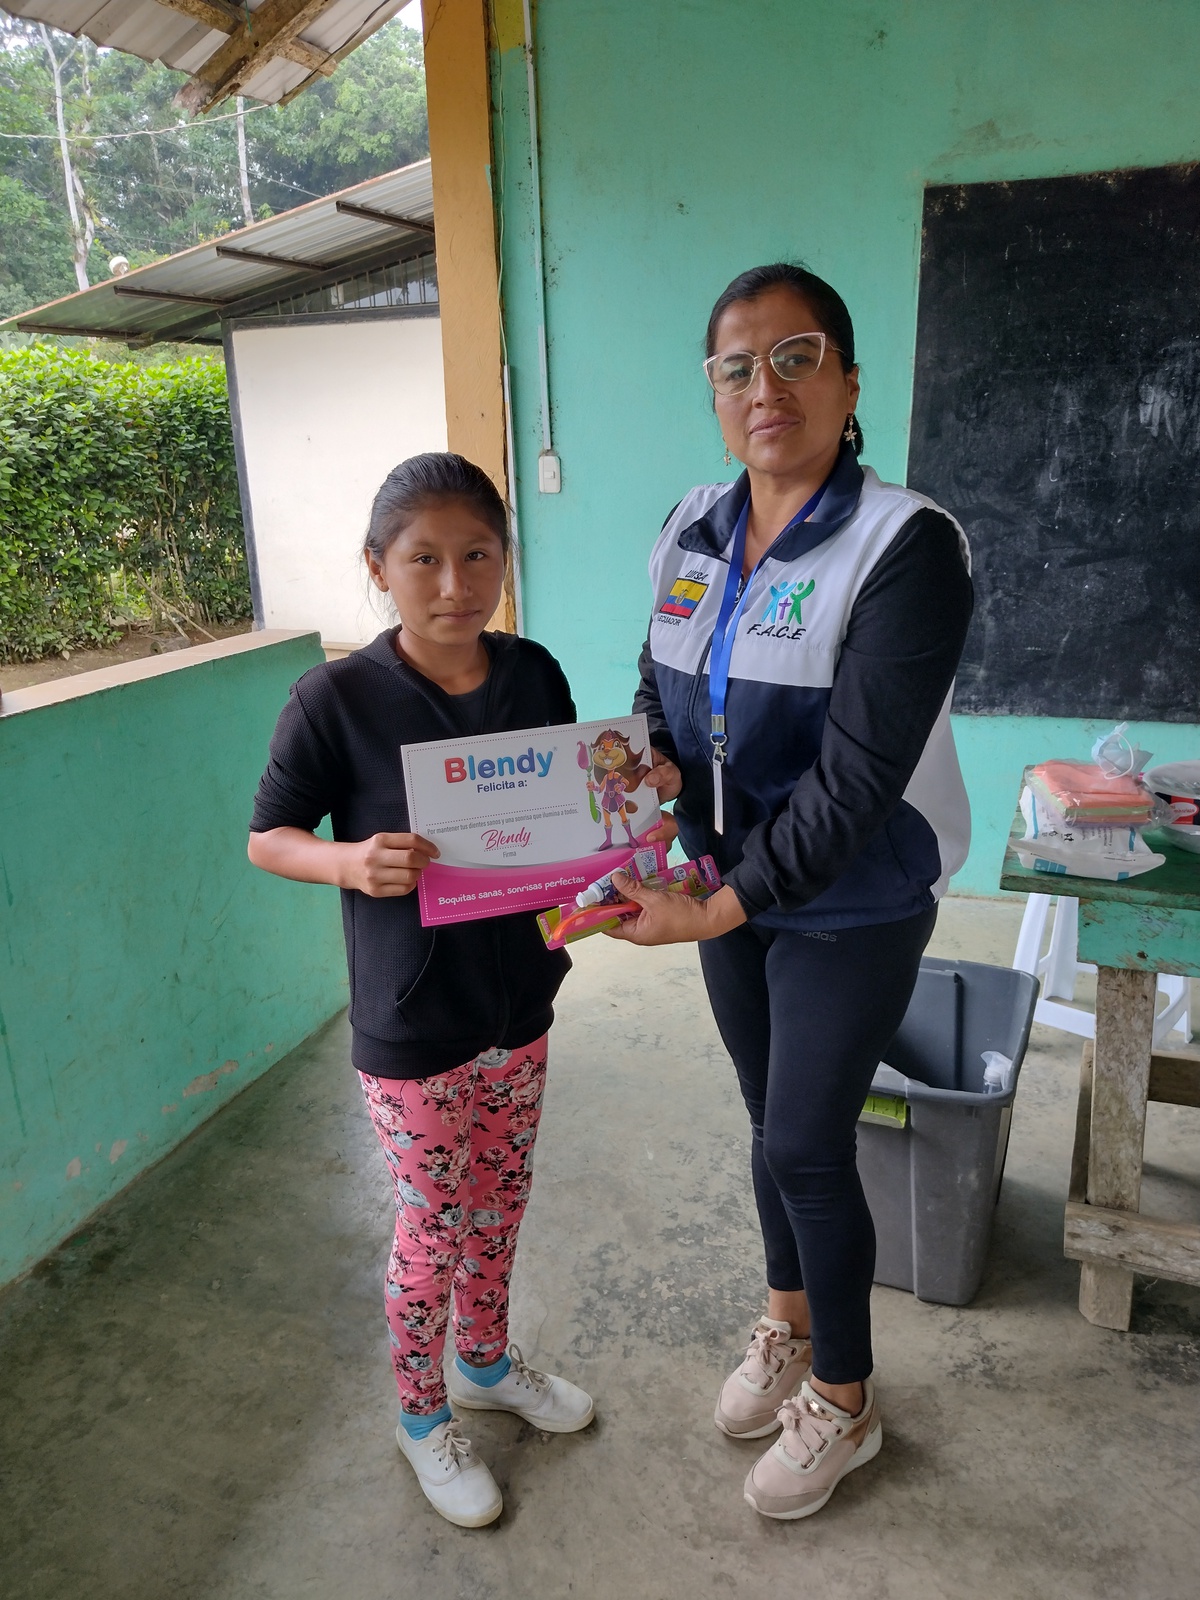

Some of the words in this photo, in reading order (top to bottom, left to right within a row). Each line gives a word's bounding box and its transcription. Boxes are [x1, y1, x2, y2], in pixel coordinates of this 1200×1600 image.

[747, 624, 806, 640] F.A.C.E
[444, 747, 553, 783] Blendy
[477, 780, 515, 793] Felicita
[517, 779, 528, 788] a:
[436, 825, 460, 834] mantener
[460, 823, 468, 831] tus
[468, 821, 486, 829] dientes
[486, 819, 501, 828] sanos
[515, 814, 532, 823] sonrisa
[533, 813, 542, 821] que
[542, 810, 560, 819] ilumina
[564, 807, 579, 815] todos.
[480, 827, 531, 850] Blendy
[502, 850, 516, 858] Firma
[438, 893, 476, 906] Boquitas
[478, 889, 505, 900] sanas,
[507, 883, 542, 895] sonrisas
[545, 876, 585, 890] perfectas
